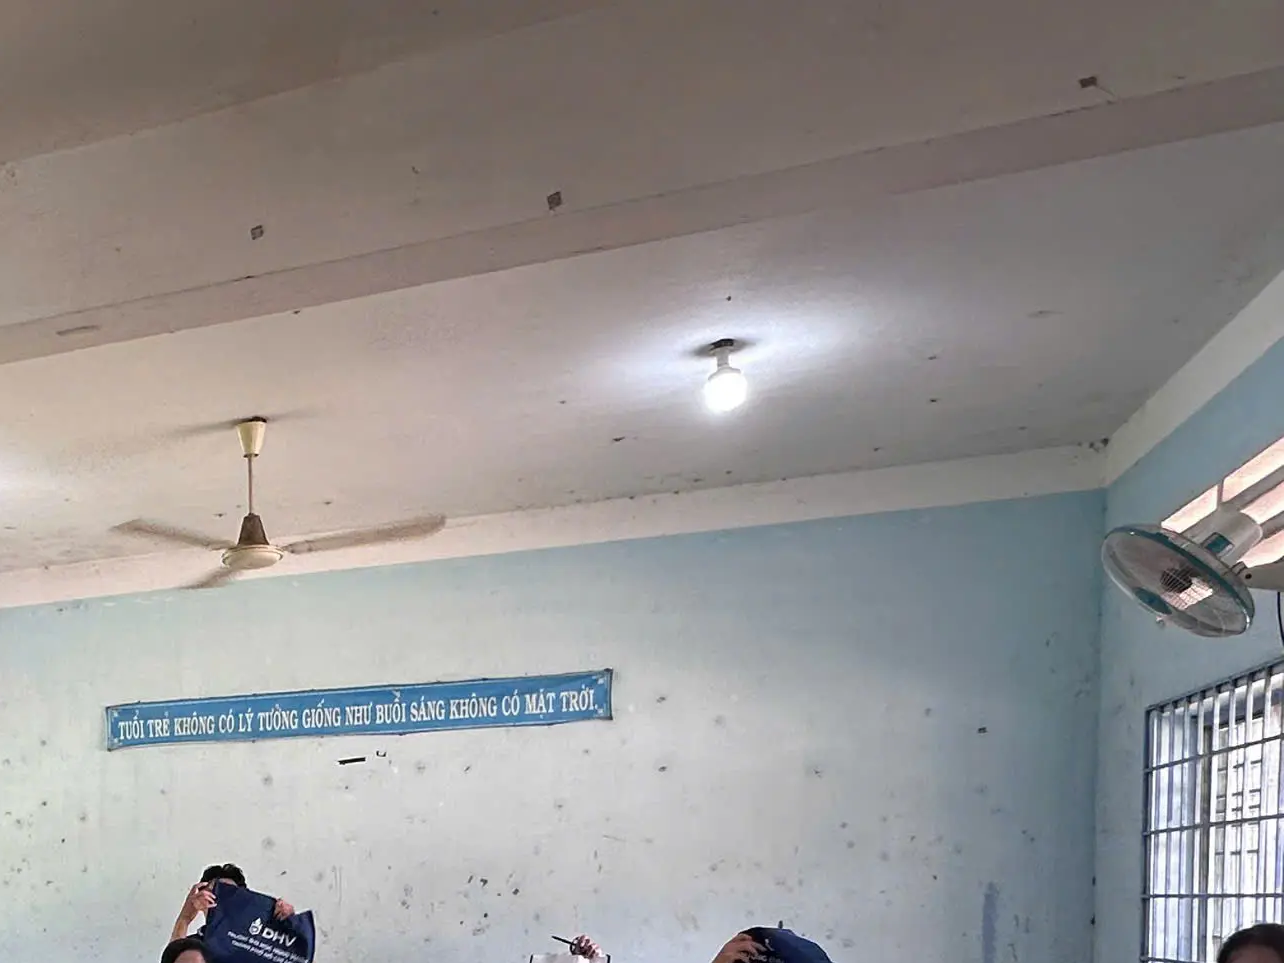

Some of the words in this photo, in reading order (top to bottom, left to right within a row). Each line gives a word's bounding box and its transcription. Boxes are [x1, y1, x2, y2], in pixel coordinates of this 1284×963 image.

[118, 710, 144, 740] TUỔI
[147, 711, 170, 738] TRẺ
[174, 711, 215, 737] KHÔNG
[219, 709, 235, 733] CÓ
[238, 708, 253, 732] LÝ
[258, 703, 299, 731] TƯỞNG
[302, 699, 341, 729] GIỐNG
[345, 702, 373, 726] NHƯ
[375, 692, 406, 723] BUỔI
[410, 695, 445, 722] SÁNG
[449, 694, 497, 719] KHÔNG
[502, 689, 520, 716] CÓ
[524, 688, 556, 719] MẶT
[559, 684, 598, 712] TRỜI.
[262, 927, 296, 947] DHV
